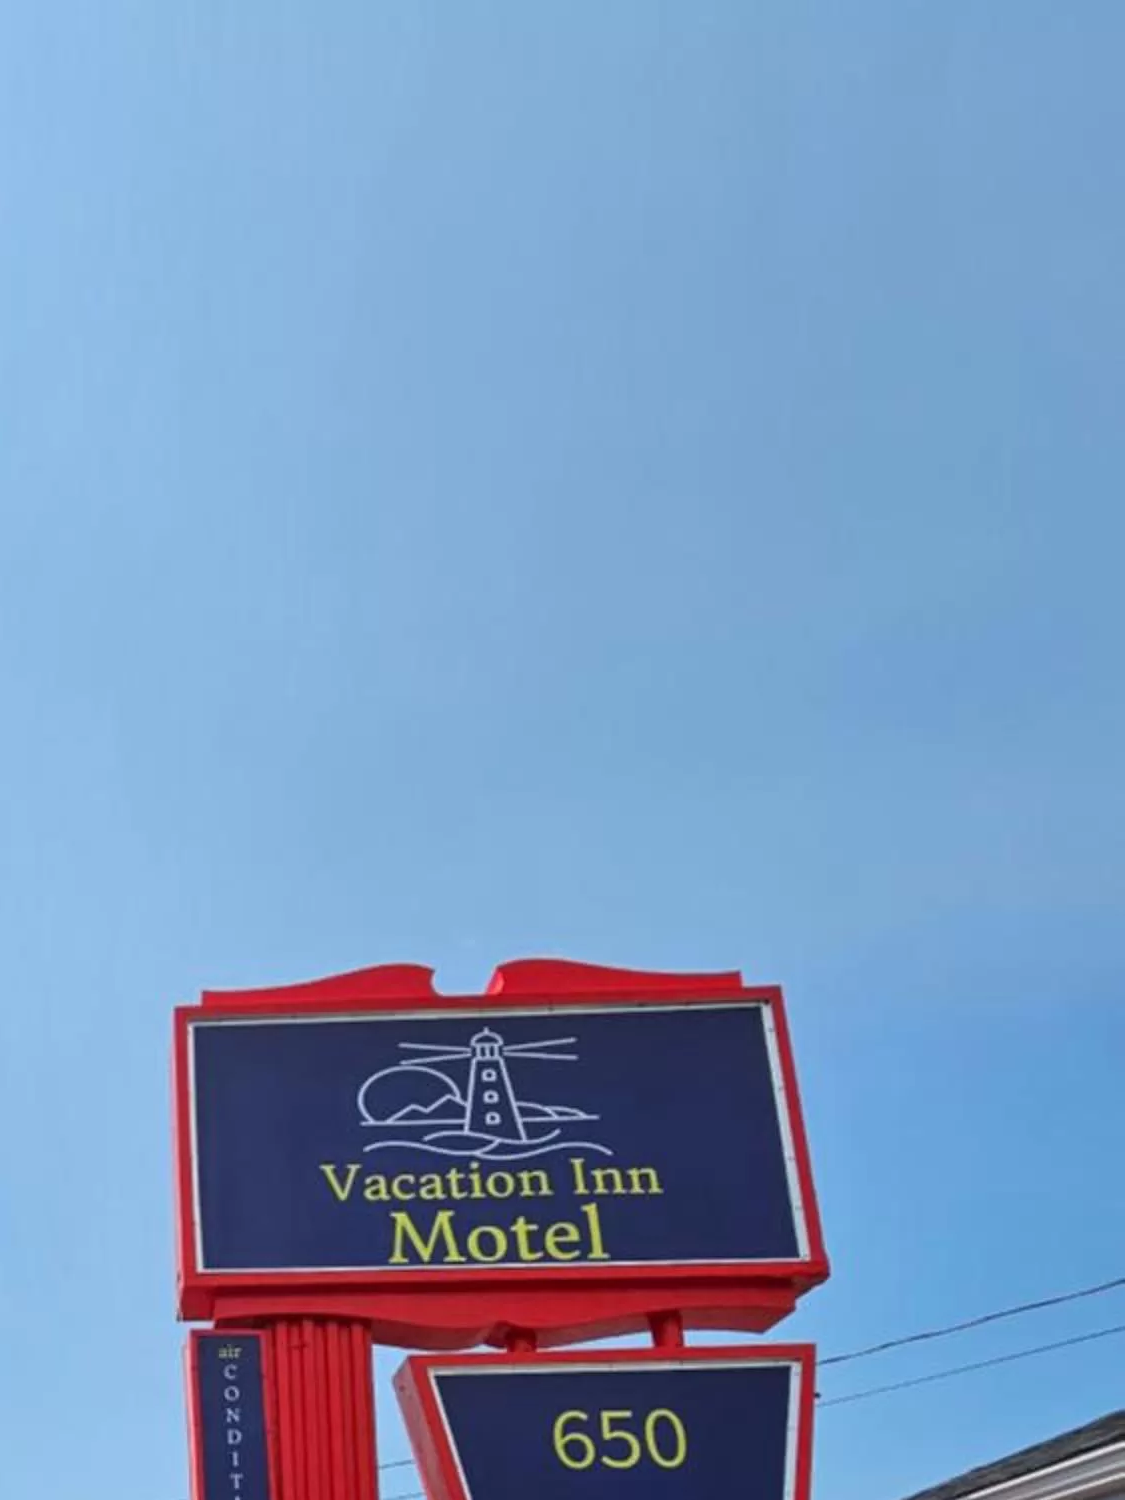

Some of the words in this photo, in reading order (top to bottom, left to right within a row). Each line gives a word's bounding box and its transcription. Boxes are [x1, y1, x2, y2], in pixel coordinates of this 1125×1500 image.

[320, 1161, 554, 1201] Vacation
[570, 1157, 664, 1196] Inn
[388, 1202, 611, 1264] Motel
[218, 1344, 243, 1359] air
[553, 1408, 687, 1469] 650
